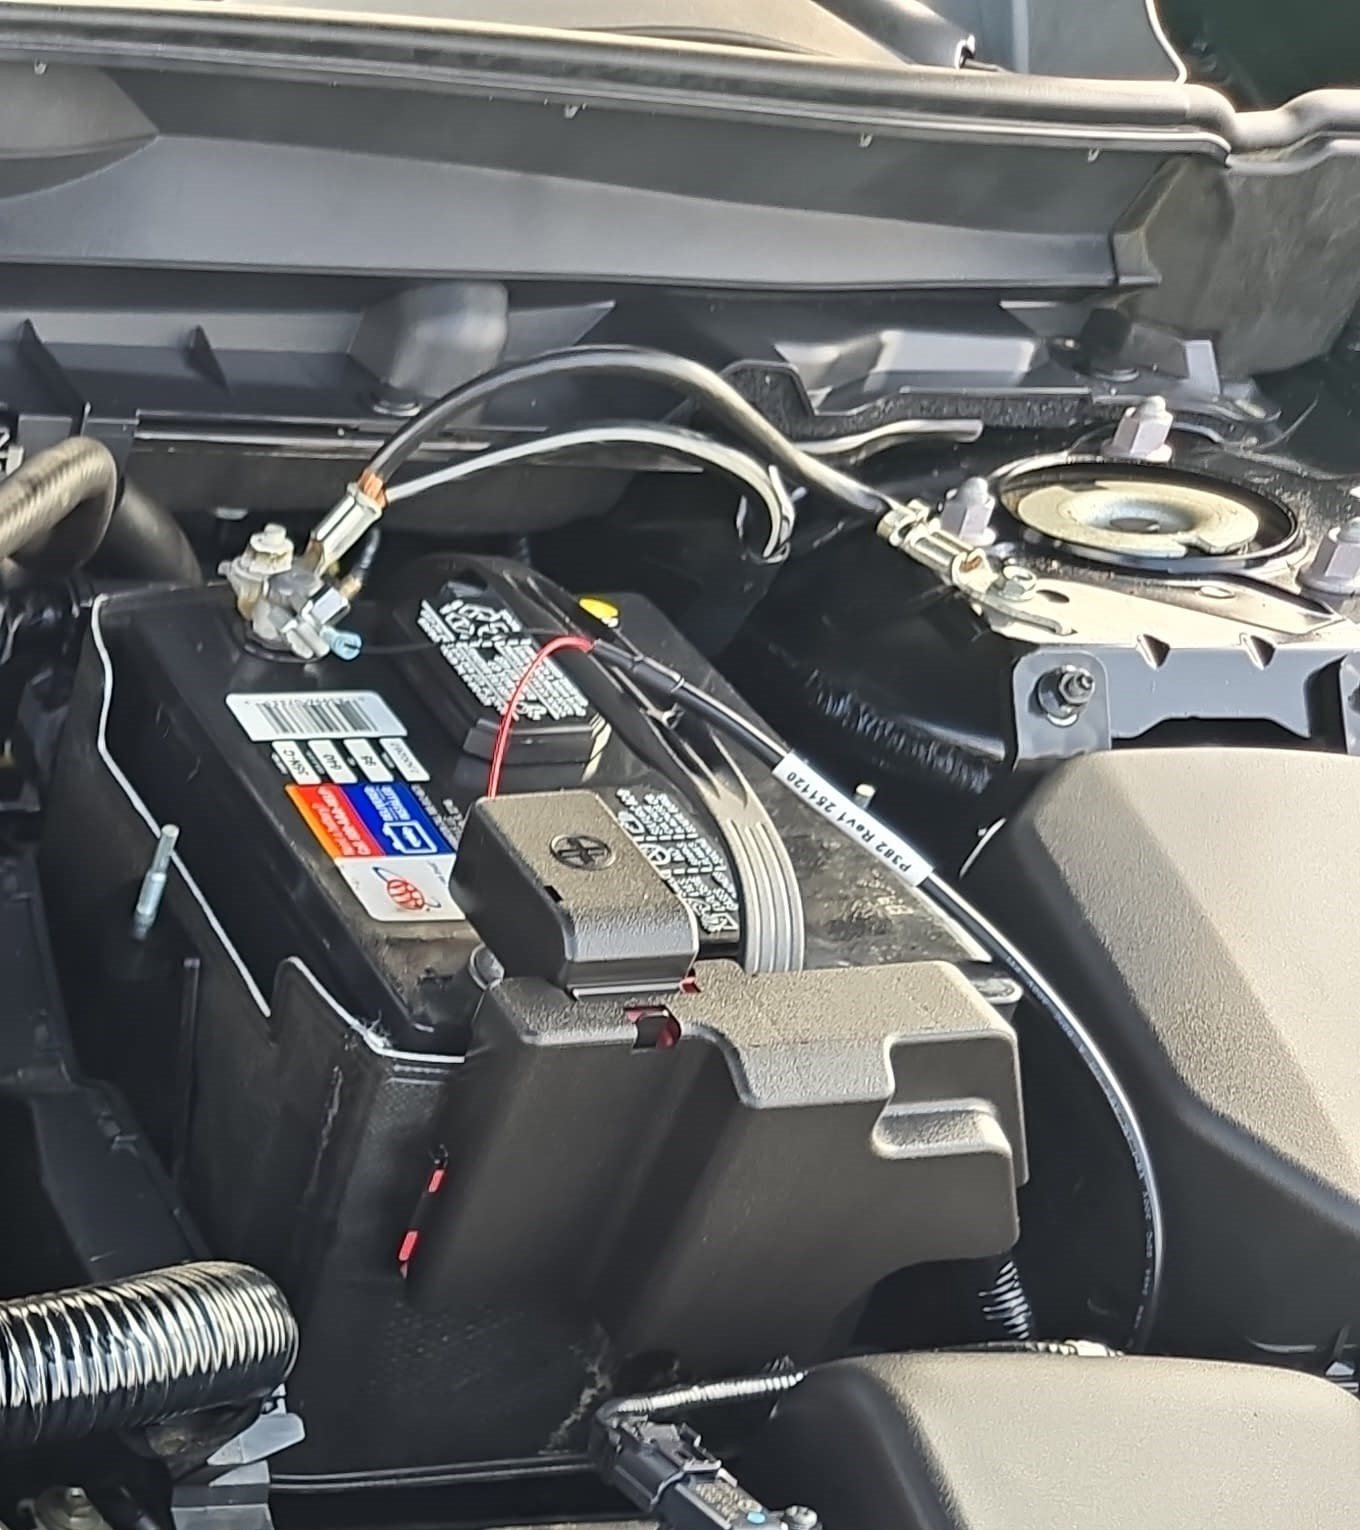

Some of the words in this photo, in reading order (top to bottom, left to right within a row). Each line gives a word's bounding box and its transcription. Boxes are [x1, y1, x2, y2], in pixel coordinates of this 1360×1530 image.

[786, 771, 837, 814] 251120
[836, 811, 876, 843] Rev1
[875, 841, 912, 873] P382
